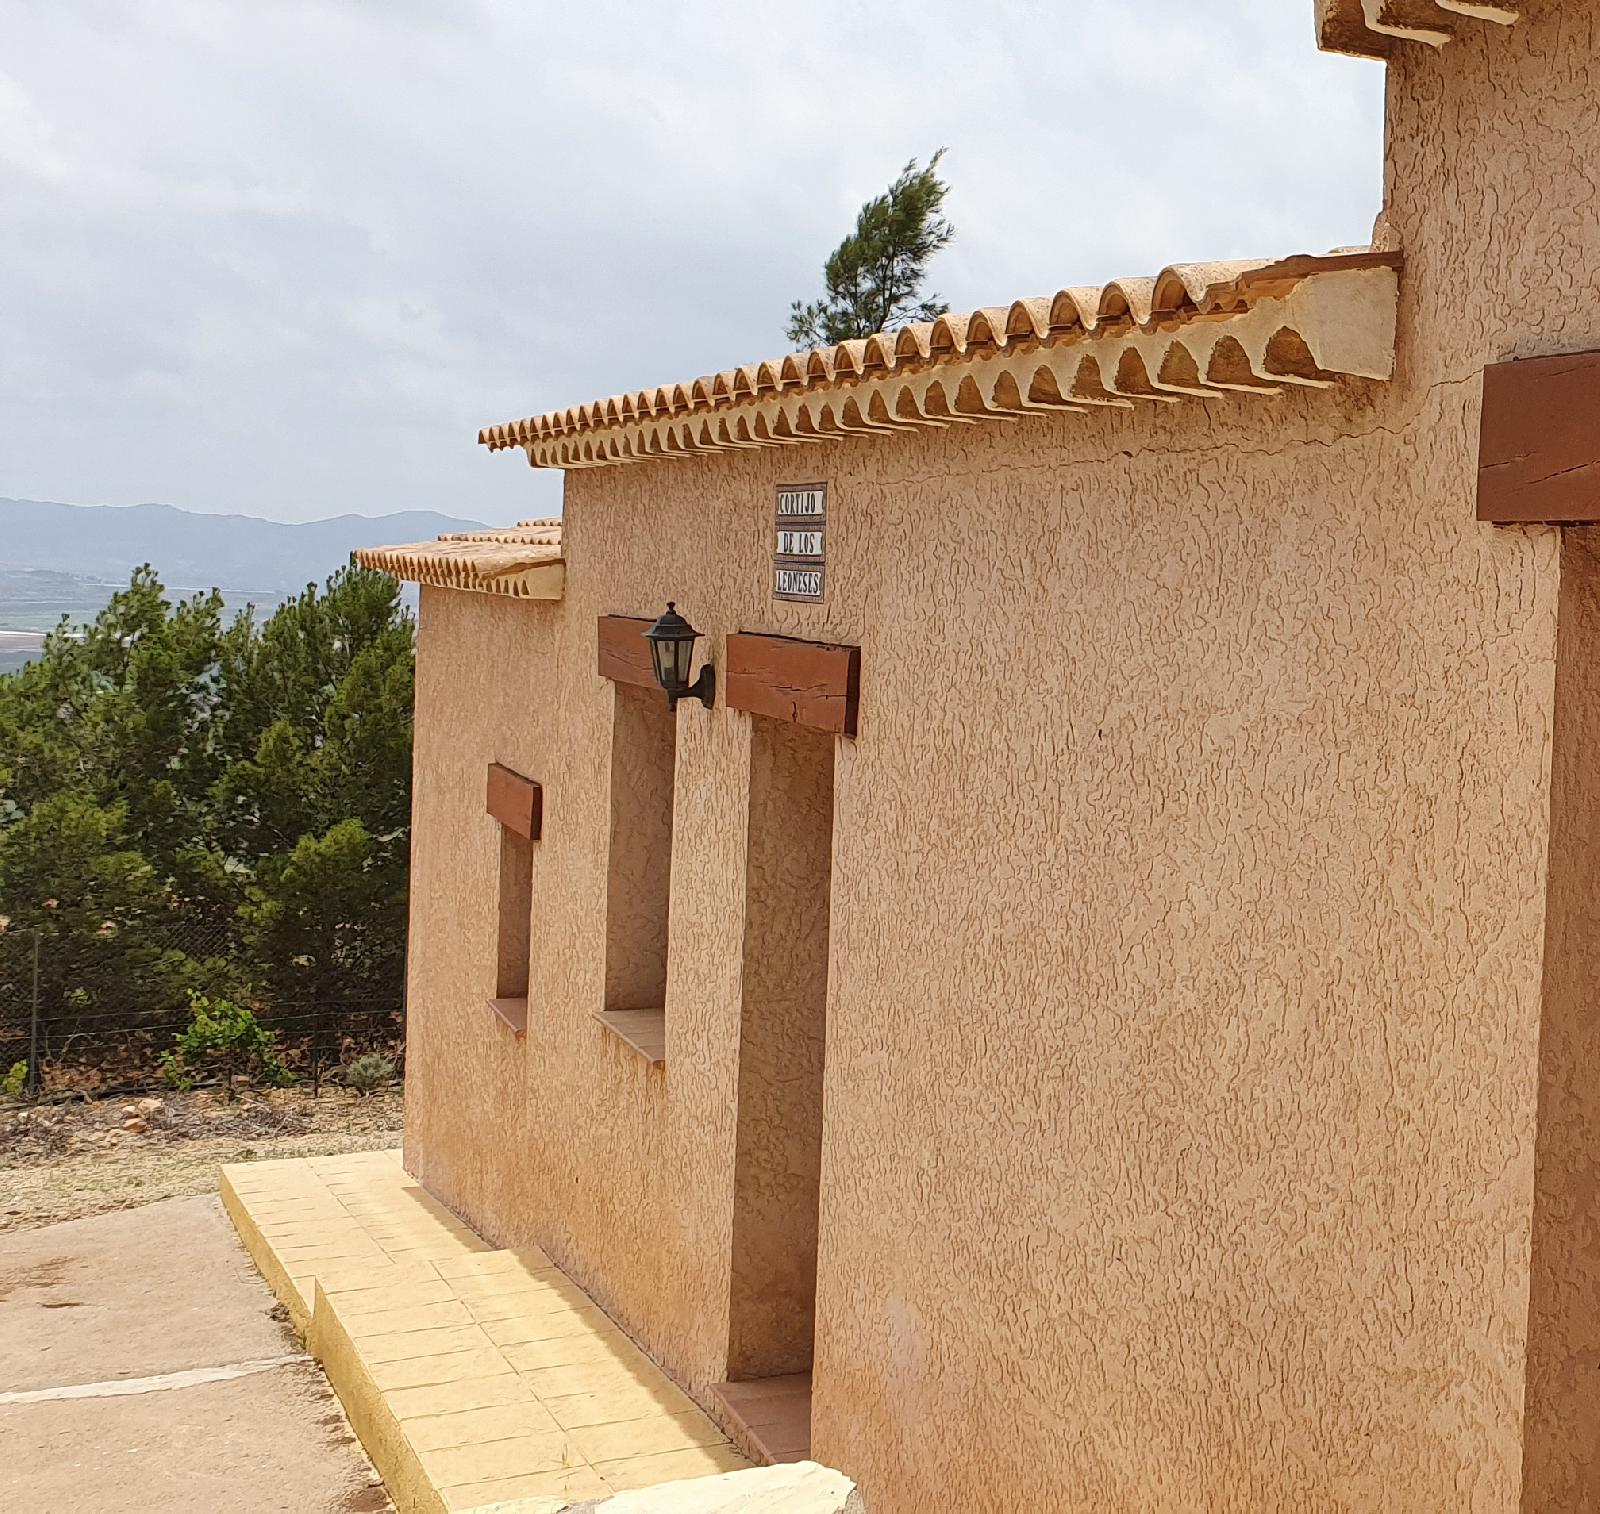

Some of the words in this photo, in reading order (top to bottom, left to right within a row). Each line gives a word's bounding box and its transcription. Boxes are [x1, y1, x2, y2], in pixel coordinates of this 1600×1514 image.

[780, 492, 816, 514] CORTIJO
[783, 532, 794, 553] DE
[799, 533, 815, 554] LOS
[777, 571, 819, 594] LEONESES
